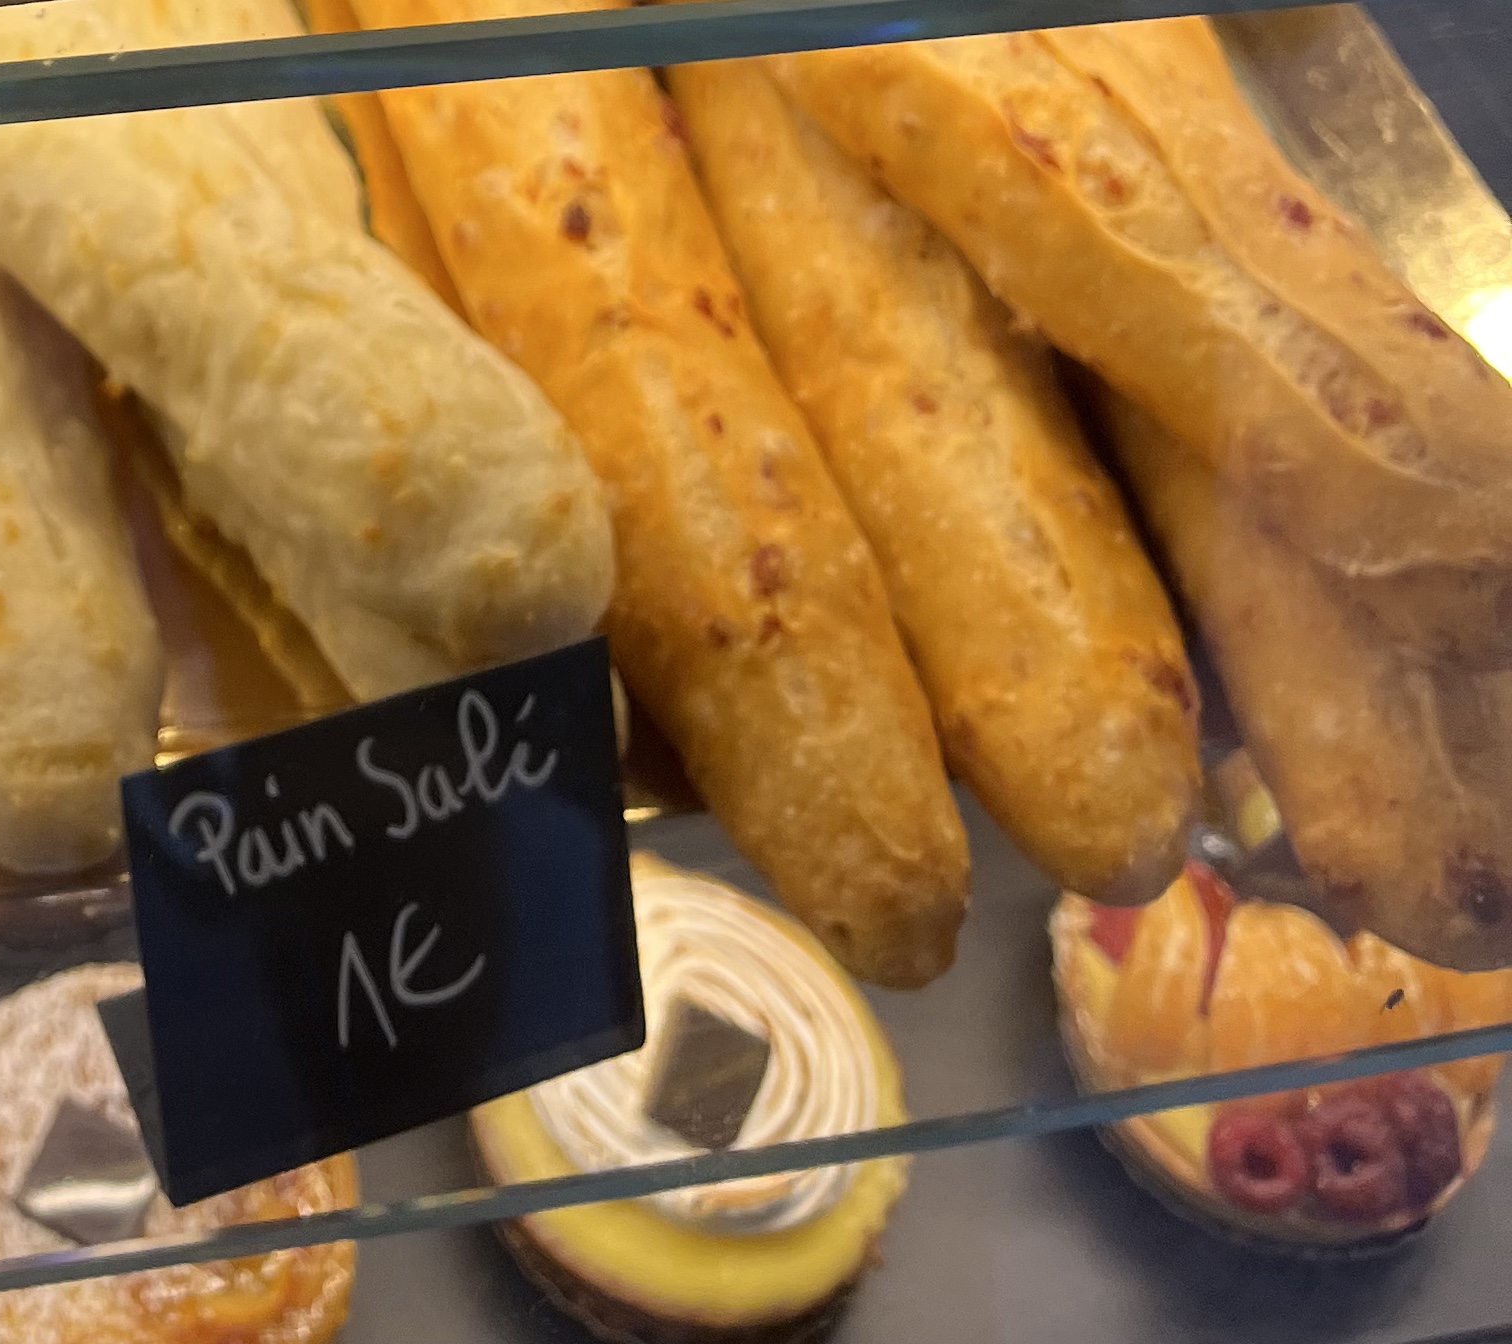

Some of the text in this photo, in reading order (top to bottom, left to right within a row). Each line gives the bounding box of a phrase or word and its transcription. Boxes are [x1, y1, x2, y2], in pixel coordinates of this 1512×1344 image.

[169, 688, 558, 895] Pain Salé
[337, 903, 485, 1048] 1€
